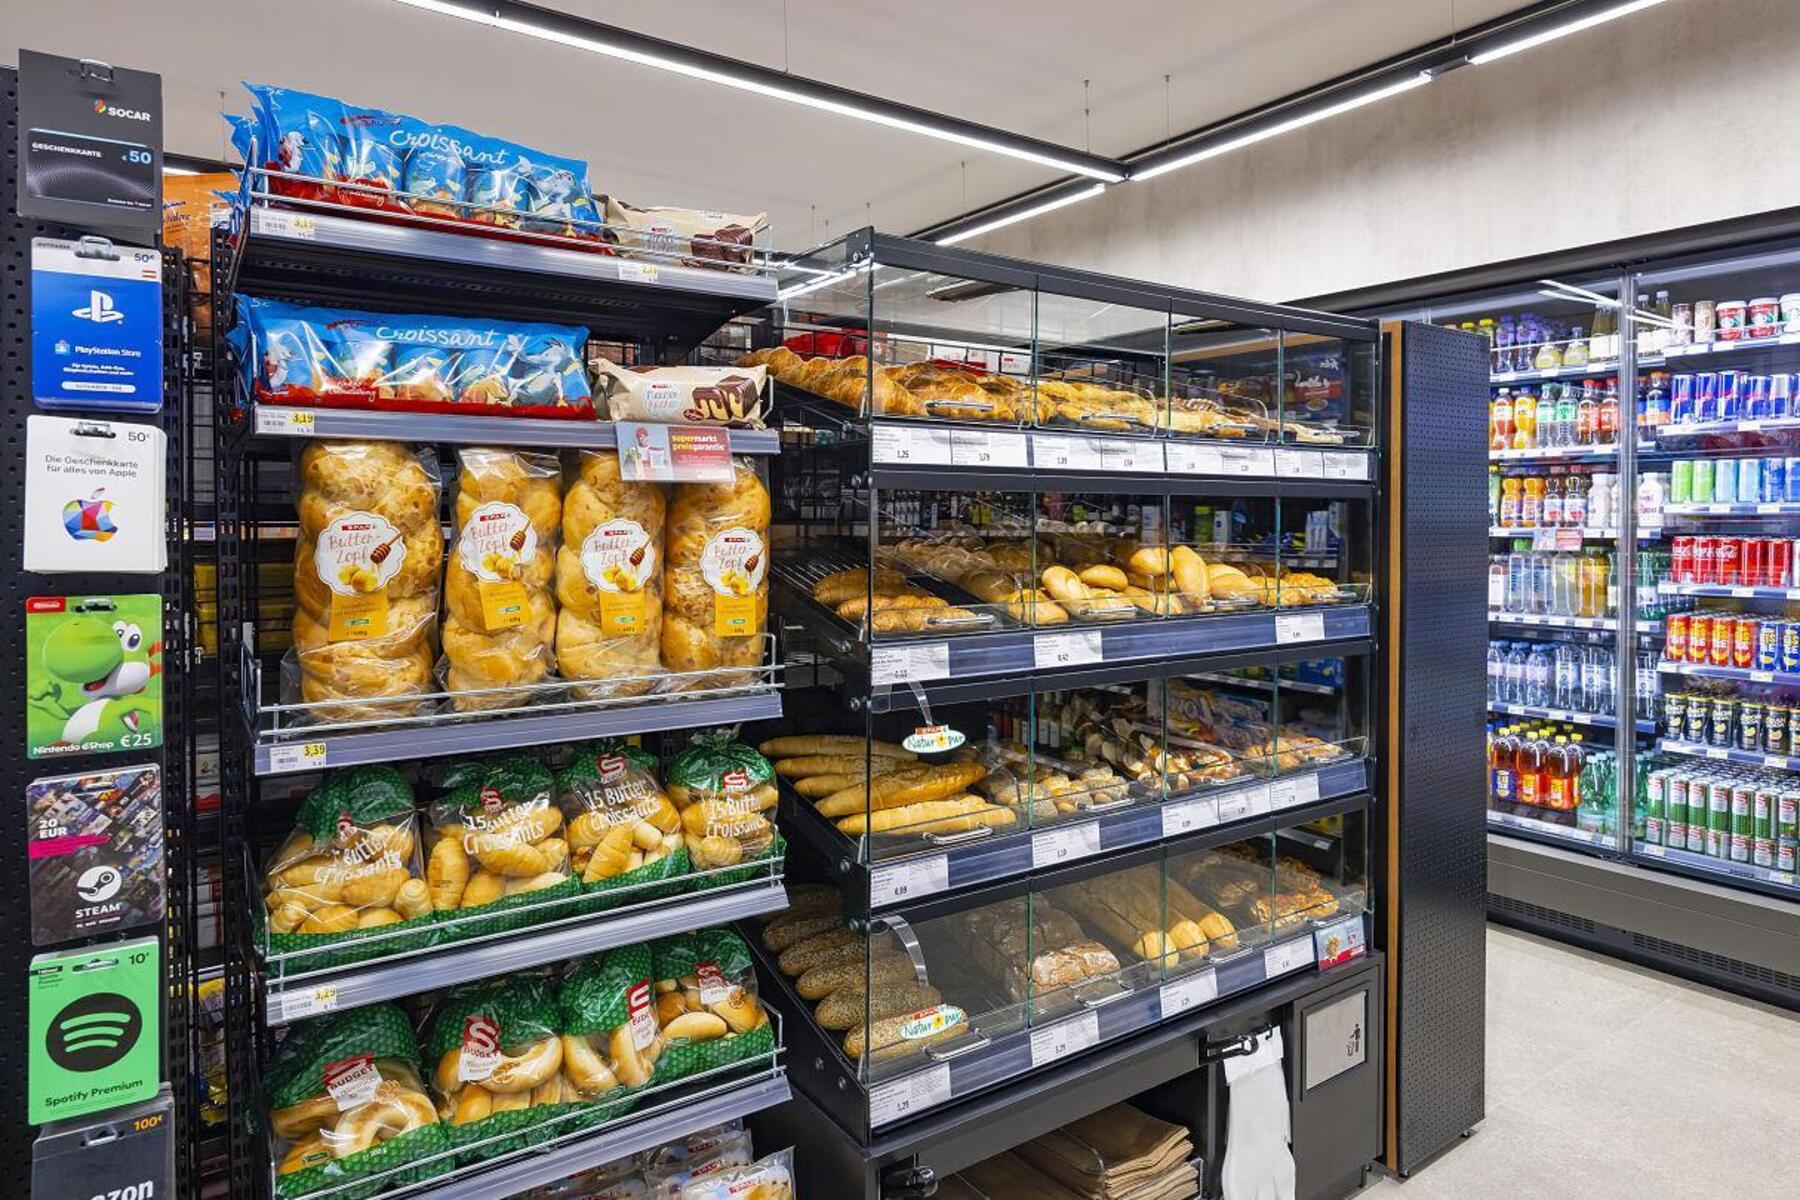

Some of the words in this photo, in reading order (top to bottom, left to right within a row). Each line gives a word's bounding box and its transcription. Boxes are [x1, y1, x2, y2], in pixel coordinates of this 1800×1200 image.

[108, 106, 151, 122] SOCAR
[32, 142, 102, 158] GESCHENKKARTE
[389, 129, 510, 165] Croissant
[376, 325, 500, 347] Croissant
[75, 345, 121, 357] PlayStation
[121, 349, 142, 358] Store
[45, 454, 62, 464] Die
[64, 456, 139, 469] Geschenkkarte
[47, 464, 61, 472] für
[63, 465, 87, 475] alles
[109, 469, 137, 478] Apple
[336, 547, 369, 565] Zopf
[33, 744, 80, 754] Nintendo
[82, 741, 114, 751] eShop
[584, 790, 604, 810] 15
[709, 798, 726, 819] 15
[590, 797, 661, 831] Croissants
[39, 818, 58, 829] 20
[39, 827, 68, 839] EUR
[75, 903, 121, 919] STEAM
[904, 1020, 932, 1037] Natur
[469, 1021, 497, 1054] S
[329, 1064, 374, 1091] BUDGET
[45, 1090, 89, 1108] Spotify
[91, 1079, 144, 1098] Premium
